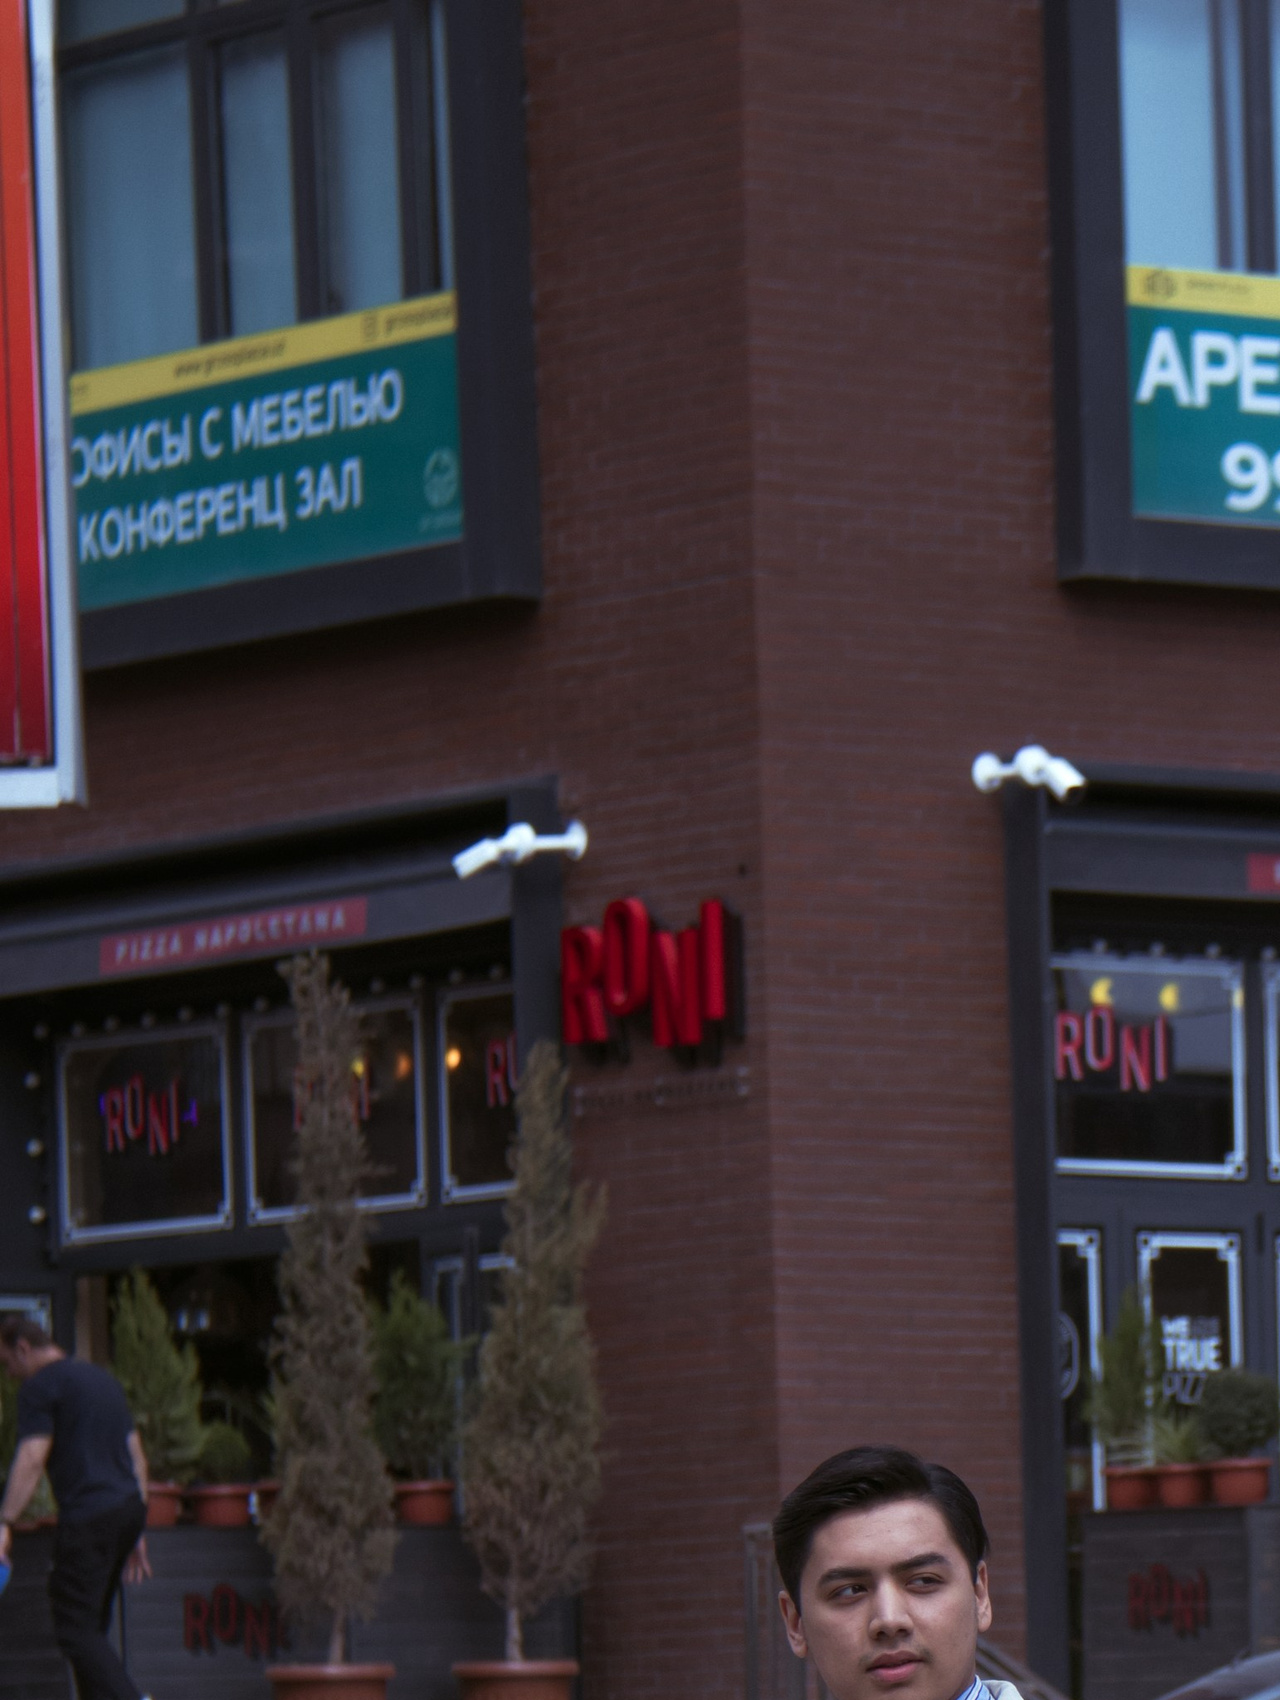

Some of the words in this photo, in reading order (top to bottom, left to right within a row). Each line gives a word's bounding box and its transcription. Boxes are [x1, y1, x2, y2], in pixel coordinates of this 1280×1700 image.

[201, 405, 224, 460] С
[231, 367, 403, 453] МЕБЕЛЬЮ
[78, 472, 287, 563] КОНФЕРЕНЦ
[295, 455, 362, 520] ЗАЛ
[115, 931, 182, 965] PIZZA
[194, 906, 347, 951] NAPOLETANA
[561, 897, 726, 1048] RONI
[1055, 1004, 1168, 1093] RONI
[105, 1072, 180, 1156] RONI
[1161, 1337, 1221, 1371] TRUE
